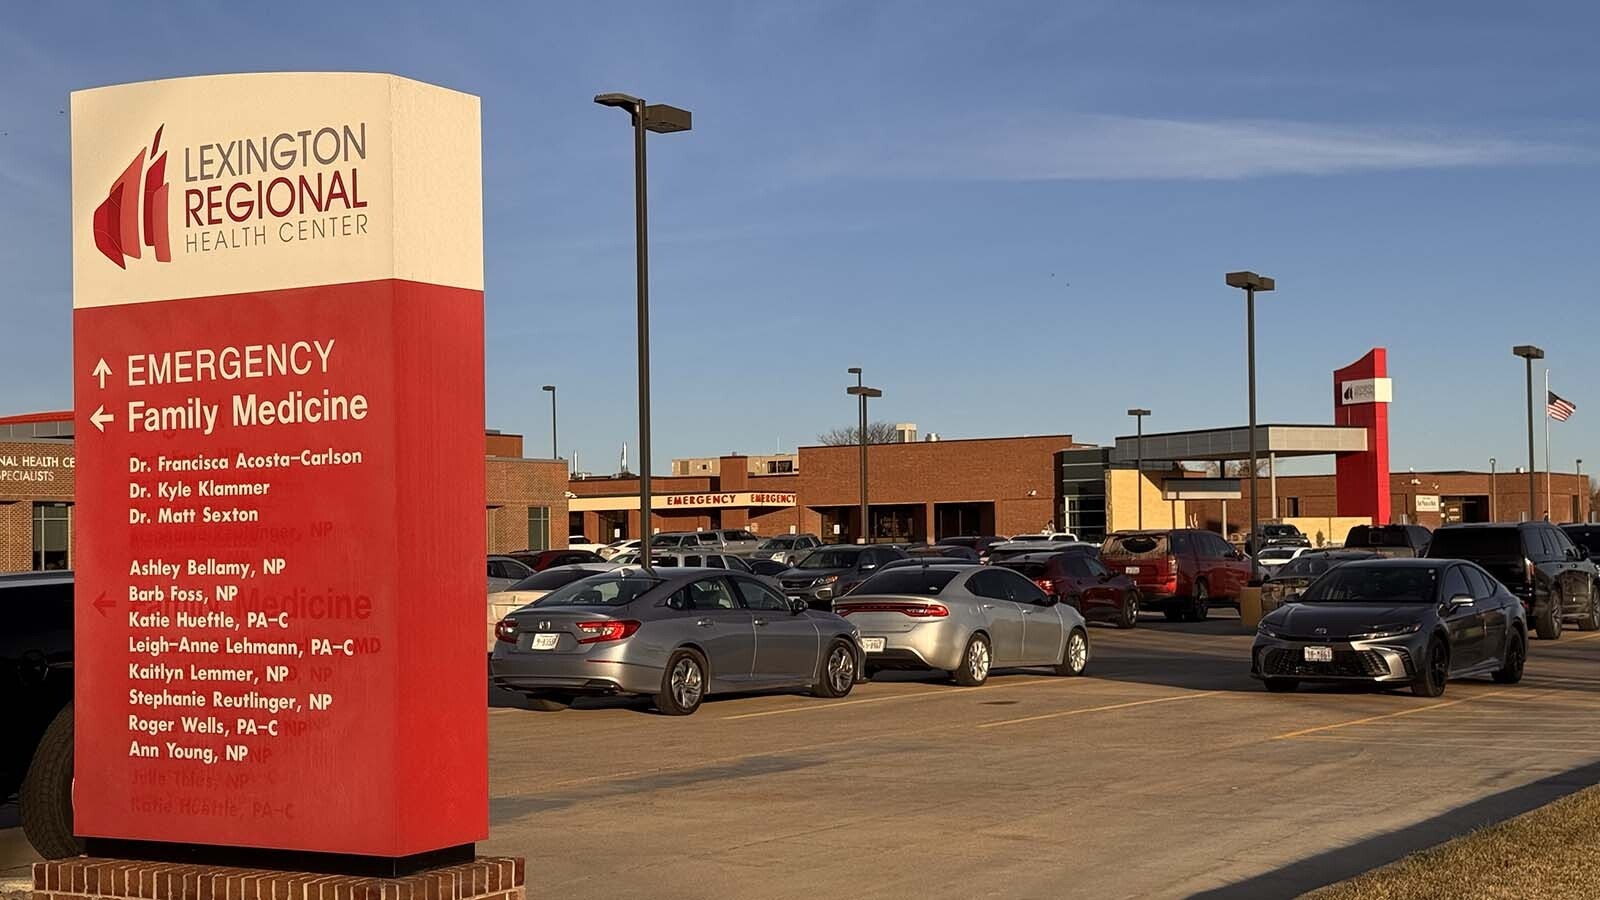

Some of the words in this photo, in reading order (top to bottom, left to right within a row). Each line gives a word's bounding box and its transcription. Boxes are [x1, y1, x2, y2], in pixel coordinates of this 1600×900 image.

[185, 123, 366, 182] LEXINGTON
[186, 168, 367, 228] REGIONAL
[186, 221, 266, 253] HEALTH
[279, 214, 367, 242] CENTER
[127, 339, 335, 387] EMERGENCY
[128, 397, 219, 435] Family
[232, 388, 368, 427] Medicine
[22, 456, 59, 468] HEALTH
[129, 457, 152, 473] Dr.
[158, 454, 229, 472] Francisca
[0, 470, 55, 482] PECIALISTS
[129, 482, 152, 499] Dr.
[158, 480, 192, 502] Kyle
[198, 479, 270, 497] Klammer
[667, 495, 736, 506] EMERGENCY
[751, 494, 796, 503] EMERGENCY
[129, 508, 151, 524] Dr.
[158, 507, 196, 524] Matt
[202, 506, 258, 523] Sexton
[129, 558, 181, 580] Ashley
[187, 558, 256, 580] Bellamy,
[263, 558, 286, 575] NP
[129, 585, 165, 602] Barb
[170, 585, 209, 605] Foss,
[216, 585, 238, 602] NP
[129, 611, 170, 628] Katie
[176, 611, 240, 631] Hueftle,
[247, 611, 289, 629] PA-C
[129, 636, 219, 654] Leigh-Anne
[226, 636, 303, 659] Lehmann,
[311, 638, 354, 657] PA-C
[129, 662, 184, 684] Kaitlyn
[190, 664, 259, 685] Lemmer,
[266, 665, 289, 682] NP
[129, 688, 206, 710] Stephanie
[213, 691, 302, 715] Reutlinger,
[309, 693, 333, 711] NP
[129, 714, 175, 736] Roger
[181, 716, 230, 737] Wells,
[237, 718, 278, 737] PA-C
[129, 740, 159, 757] Ann
[166, 742, 218, 765] Young,
[226, 744, 249, 762] NP
